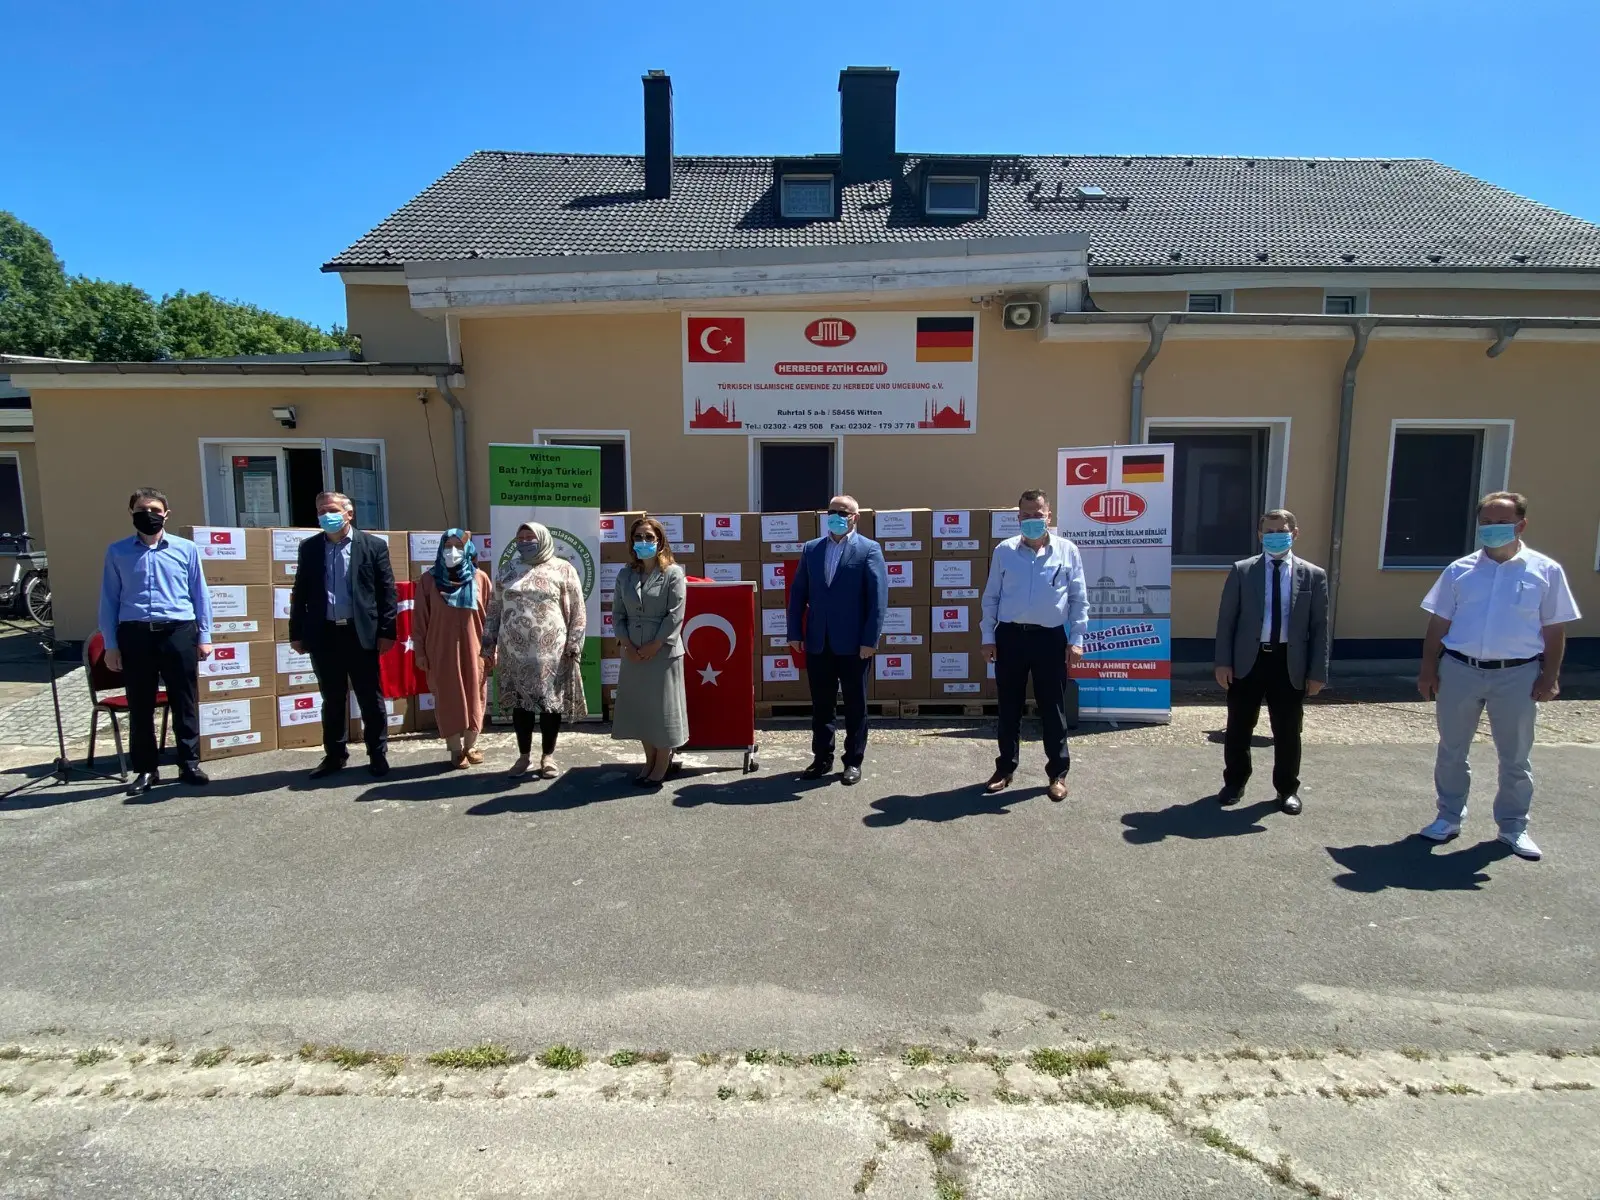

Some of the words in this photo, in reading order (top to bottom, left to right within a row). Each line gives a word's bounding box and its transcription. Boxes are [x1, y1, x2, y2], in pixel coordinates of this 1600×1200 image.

[778, 365, 824, 373] HERBEDE
[826, 363, 853, 373] FATİH
[529, 453, 561, 462] Witten
[498, 466, 518, 474] Batı
[520, 466, 553, 476] Trakya
[555, 467, 592, 476] Türkleri
[508, 479, 569, 489] Yardımlaşma
[500, 492, 552, 502] Dayanışma
[554, 493, 591, 503] Derneği
[1089, 529, 1107, 537] İŞLERİ
[1108, 528, 1124, 537] TÜRK
[1125, 528, 1144, 536] İSLAM
[578, 543, 586, 553] ve
[1083, 623, 1154, 641] osgeldiniz
[1082, 636, 1160, 653] illkommen
